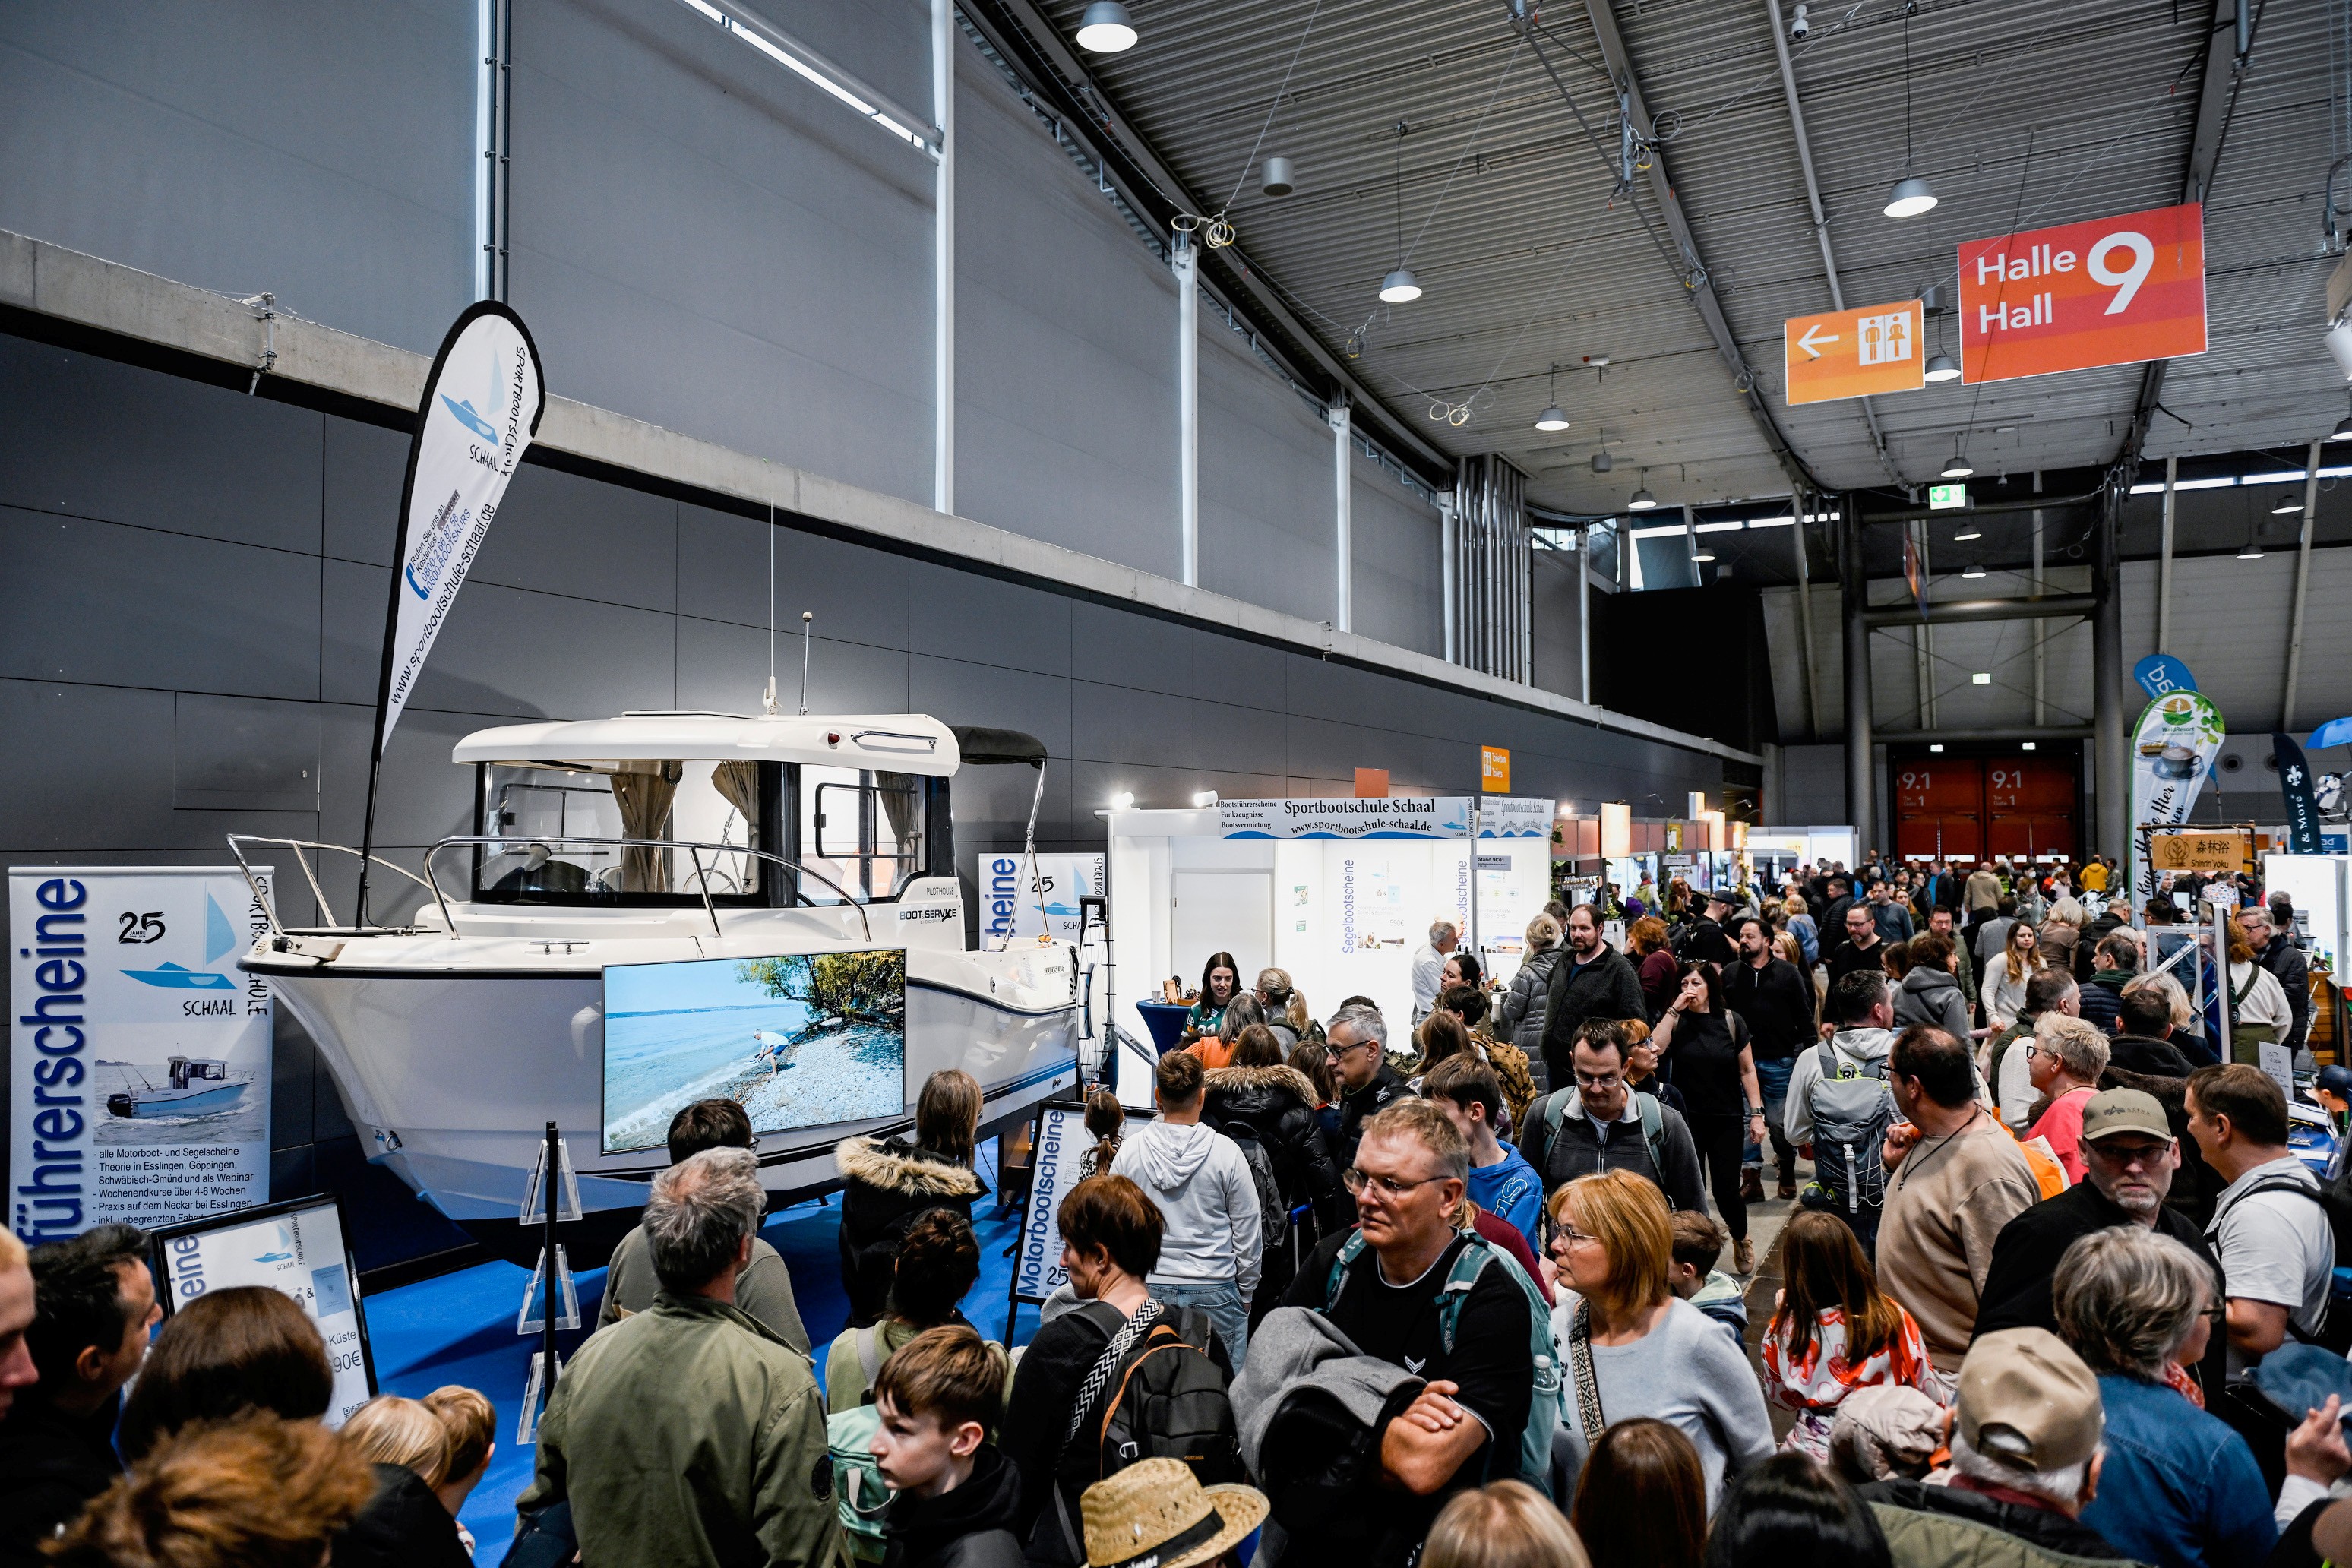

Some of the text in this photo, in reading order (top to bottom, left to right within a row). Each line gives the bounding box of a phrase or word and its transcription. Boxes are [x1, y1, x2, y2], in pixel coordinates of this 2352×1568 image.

[1977, 231, 2154, 315] Halle 9
[1979, 293, 2053, 334] Hall
[469, 444, 498, 473] SCHAAL
[411, 542, 425, 565] Rufen
[422, 528, 432, 543] Sie
[431, 514, 440, 530] uns
[421, 513, 459, 582] 0800-2 66 87 58
[416, 533, 438, 574] Kostenlos!
[426, 508, 471, 591] 0800-BOOTSKURS
[1902, 771, 1930, 789] 9.1
[1992, 770, 2022, 789] 9.1
[1220, 800, 1277, 808] Bootsführerscheine
[1285, 798, 1435, 817] Sportbootschule Schaal
[1918, 795, 1924, 807] 1
[2009, 795, 2015, 805] 1
[1221, 811, 1263, 819] Funkzeugnisse
[1221, 821, 1272, 830] Bootsvermietung
[1291, 818, 1432, 835] www.sportbootschule-schaal.de
[2196, 840, 2230, 855] 森林浴
[927, 887, 954, 896] PILOTHOUSE
[1031, 875, 1054, 893] 25
[899, 910, 923, 921] BOOT
[925, 908, 956, 920] SERVICE
[1342, 859, 1357, 953] Segelbootscheine
[119, 912, 166, 944] 25
[183, 1000, 236, 1016] SCHAAL
[99, 1146, 239, 1159] alle Motorboot- und Segelscheine
[100, 1160, 237, 1172] Theorie in Esslingen, Göppingen,
[99, 1172, 254, 1184] Schwäbisch-Gmünd und als Webinar
[99, 1186, 246, 1198] Wochenendkurse über 4-6 Wochen
[99, 1200, 253, 1211] Praxis auf dem Neckar bei Esslingen
[1017, 1110, 1065, 1296] Motorbootscheine
[170, 1235, 207, 1298] eine
[1046, 1266, 1070, 1286] 25
[307, 1287, 315, 1298] &
[330, 1350, 362, 1373] 90€
